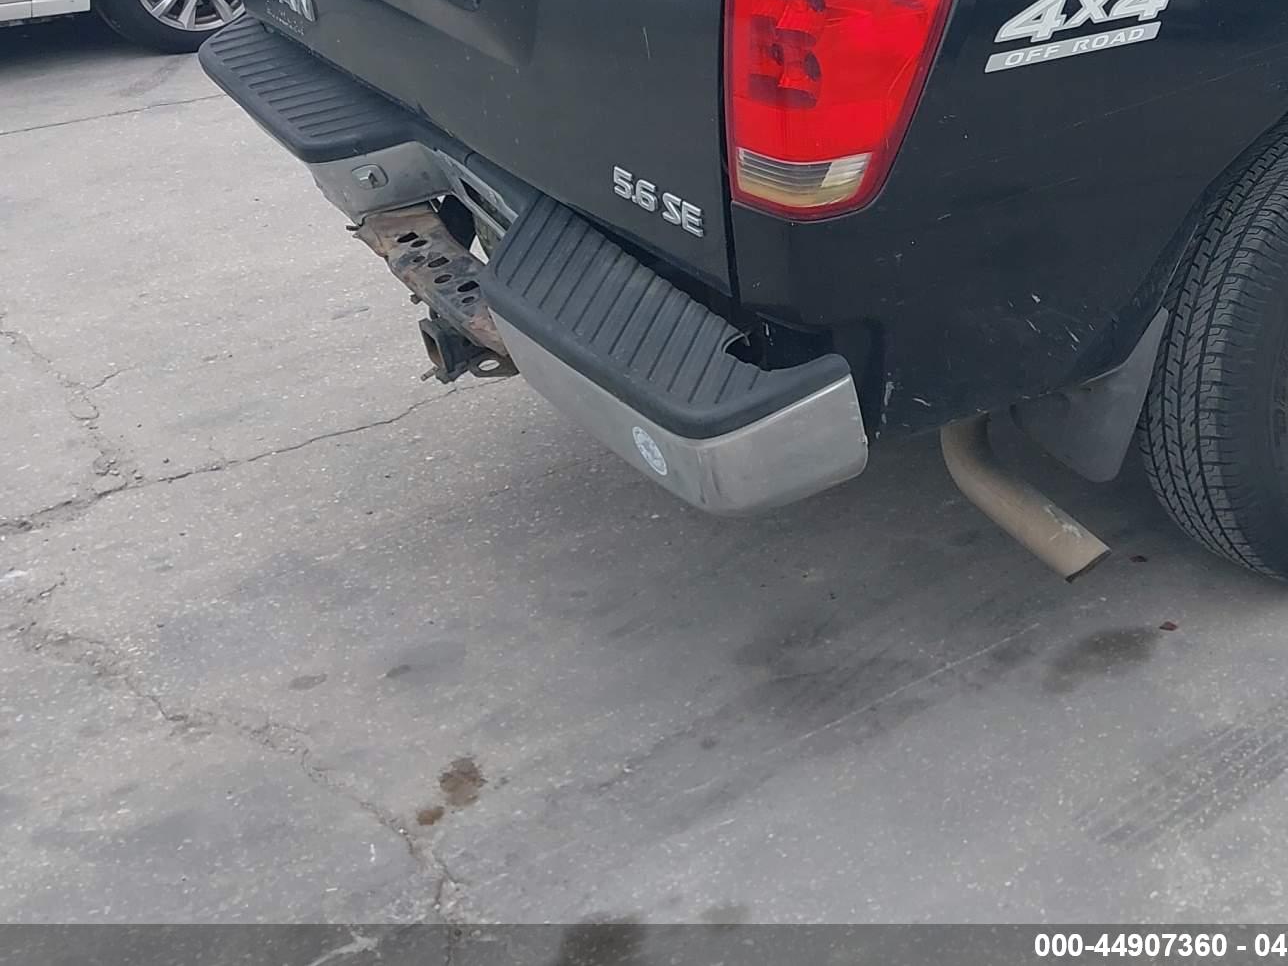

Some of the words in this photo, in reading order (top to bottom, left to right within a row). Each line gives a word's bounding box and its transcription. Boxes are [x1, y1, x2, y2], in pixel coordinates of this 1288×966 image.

[1003, 43, 1060, 67] OFF
[1071, 28, 1145, 53] ROAD
[613, 166, 659, 212] 5.6
[662, 192, 704, 238] SE
